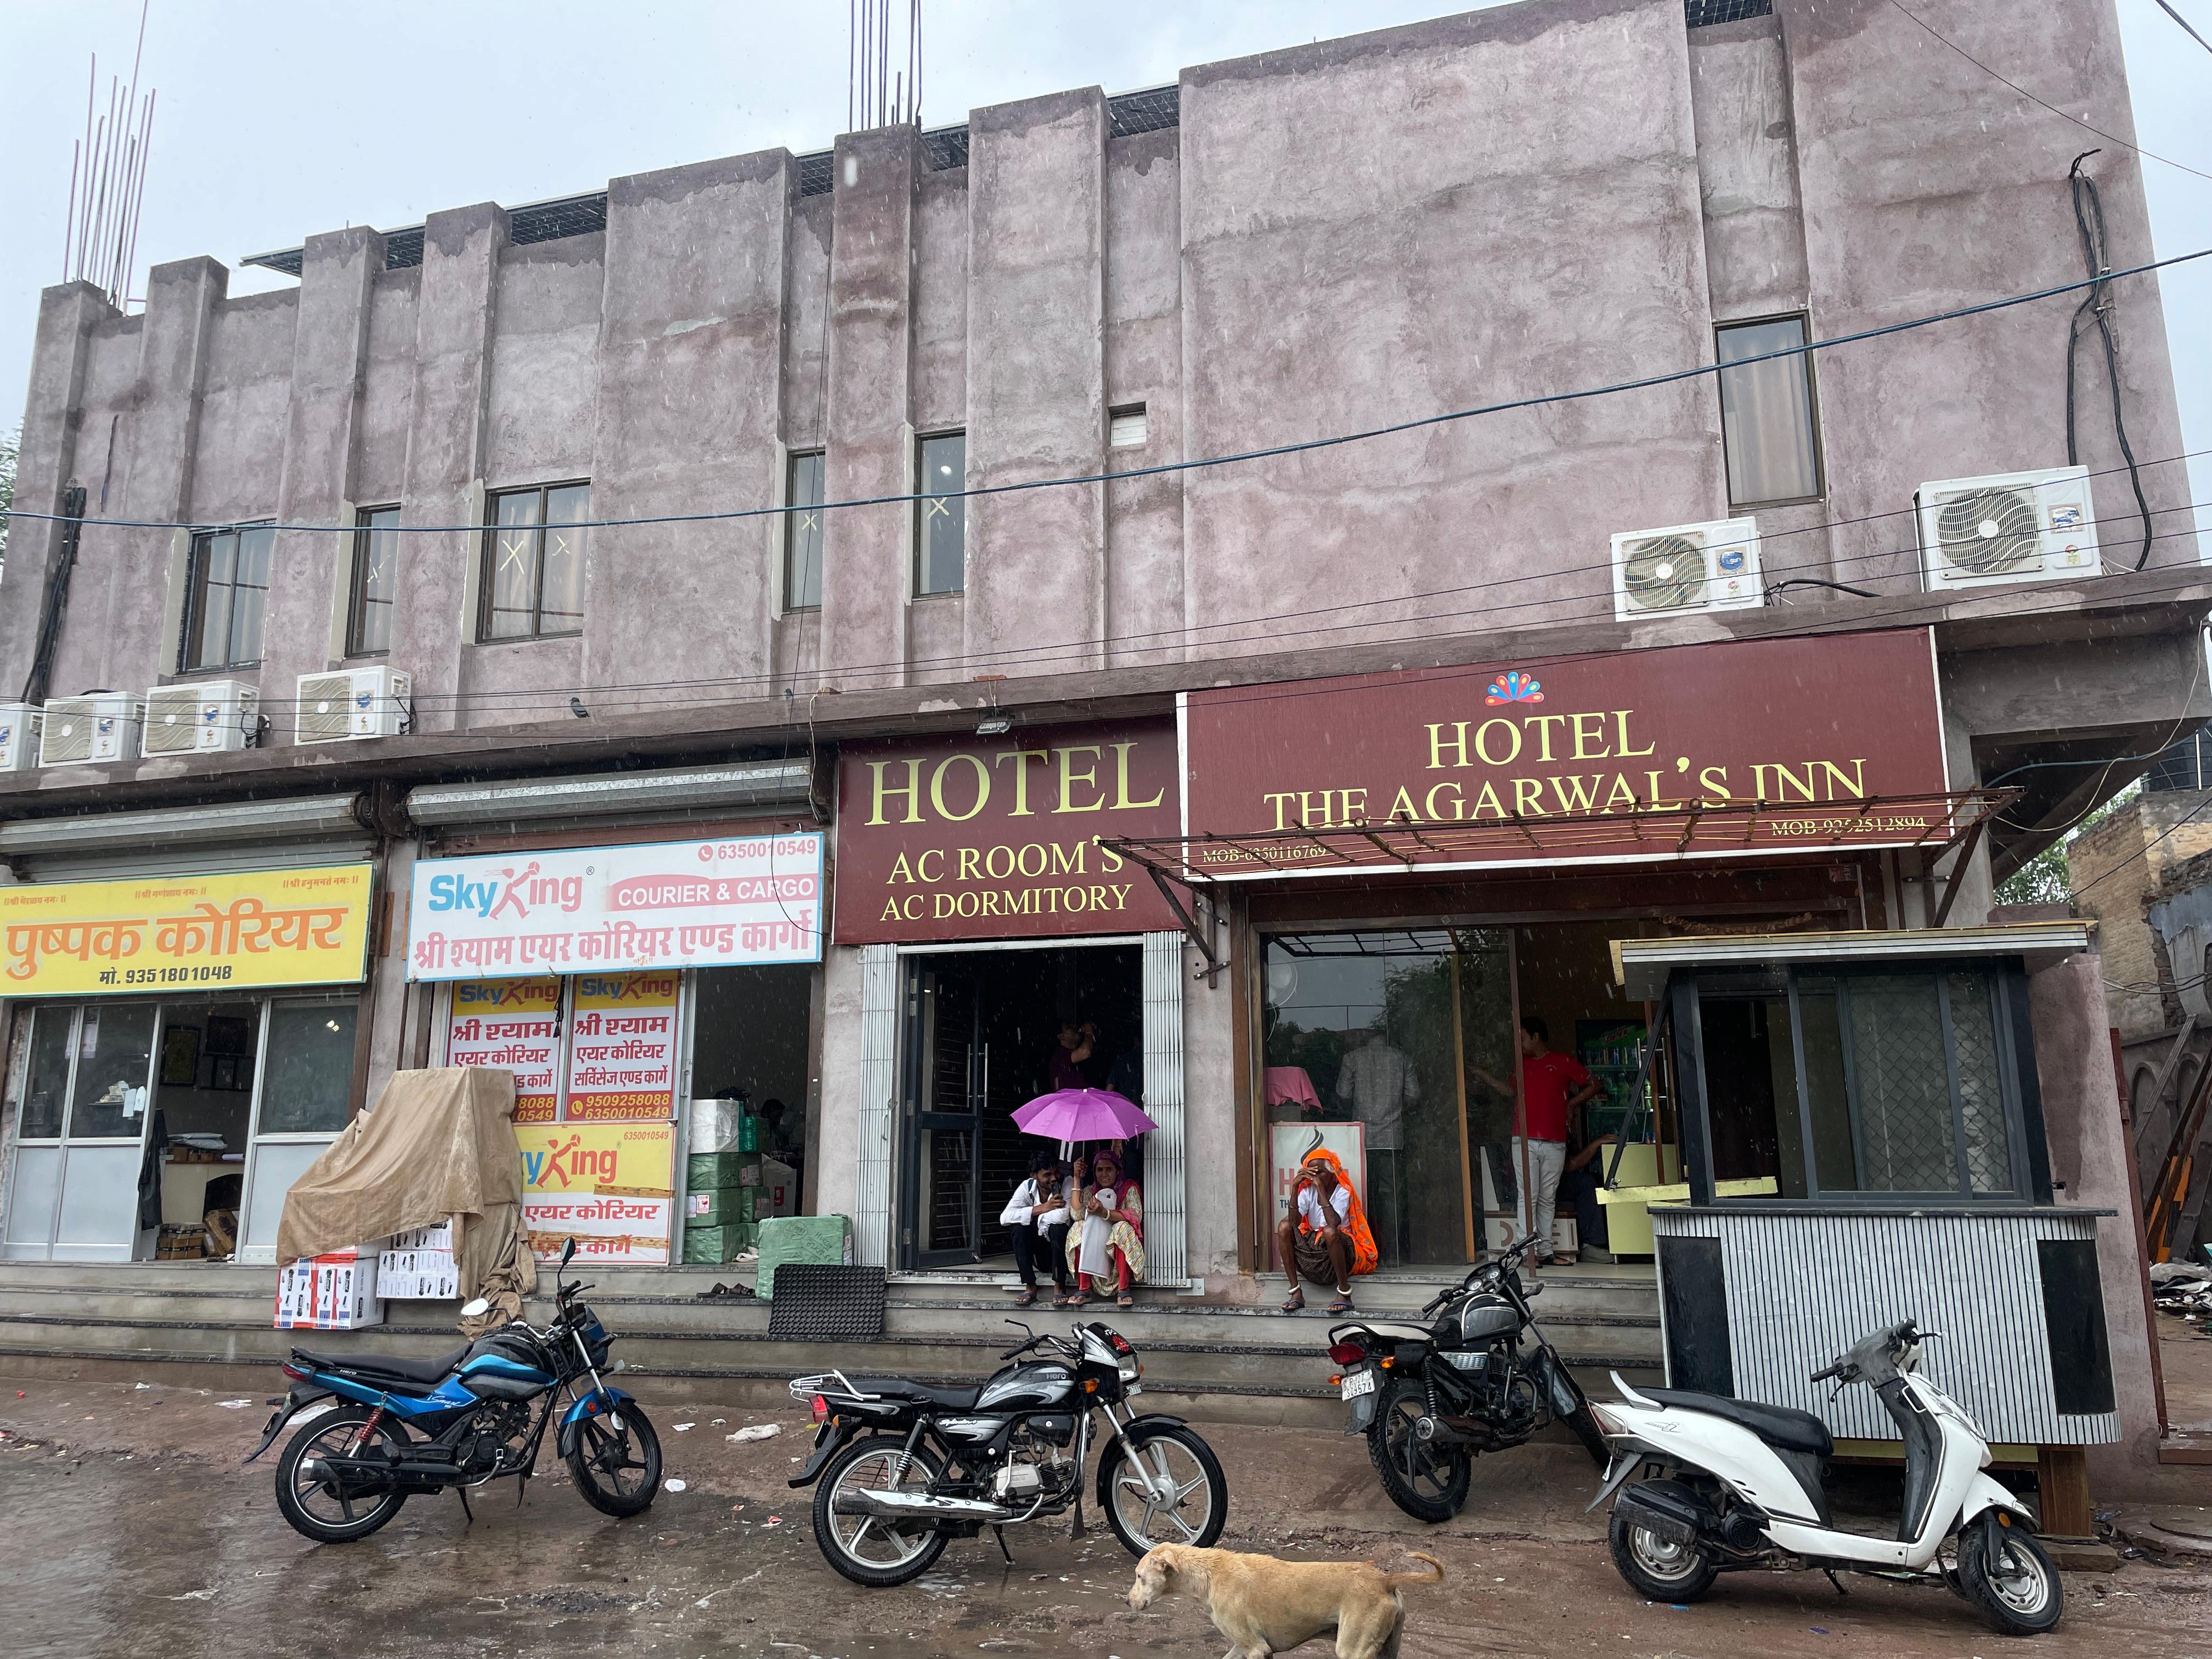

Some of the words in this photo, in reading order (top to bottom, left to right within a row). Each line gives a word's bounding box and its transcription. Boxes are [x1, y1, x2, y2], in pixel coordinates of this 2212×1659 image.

[1424, 709, 1656, 769] HOTEL
[864, 742, 1165, 826] HOTEL
[1263, 788, 1371, 831] THE
[1383, 757, 1732, 826] AGARWAL'S
[1750, 758, 1867, 803] INN
[717, 839, 817, 860] 6350010549
[886, 849, 945, 884] AC
[956, 834, 1124, 881] ROOM'S
[618, 884, 711, 907] COURIER
[716, 882, 731, 901] &
[737, 878, 815, 900] CARGO
[879, 895, 924, 922] AC
[933, 883, 1133, 919] DORMITORY
[6, 919, 148, 980] पुष्पक
[156, 898, 349, 957] कोरियर
[414, 932, 448, 969] श्री
[451, 936, 515, 968] श्याम
[519, 933, 574, 964] एयर
[578, 921, 674, 960] कोरियर
[679, 924, 736, 953] एण्ड
[99, 967, 121, 984] मो.
[126, 965, 233, 984] 9351801048
[453, 1018, 482, 1041] श्री
[486, 1021, 554, 1041] श्याम
[574, 1013, 602, 1036] श्री
[605, 1017, 670, 1036] श्याम
[454, 1051, 490, 1067] एयर
[492, 1044, 551, 1065] कोरियर
[577, 1046, 610, 1063] एयर
[611, 1040, 667, 1060] कोरियर
[619, 1070, 644, 1087] एण्ड
[585, 1093, 670, 1108] 9509258088
[585, 1107, 670, 1120] 6350010549
[623, 1131, 669, 1141] 6350010549
[524, 1205, 575, 1223] एयर
[575, 1199, 661, 1220] कोरियर
[1279, 1199, 1290, 1209] TH
